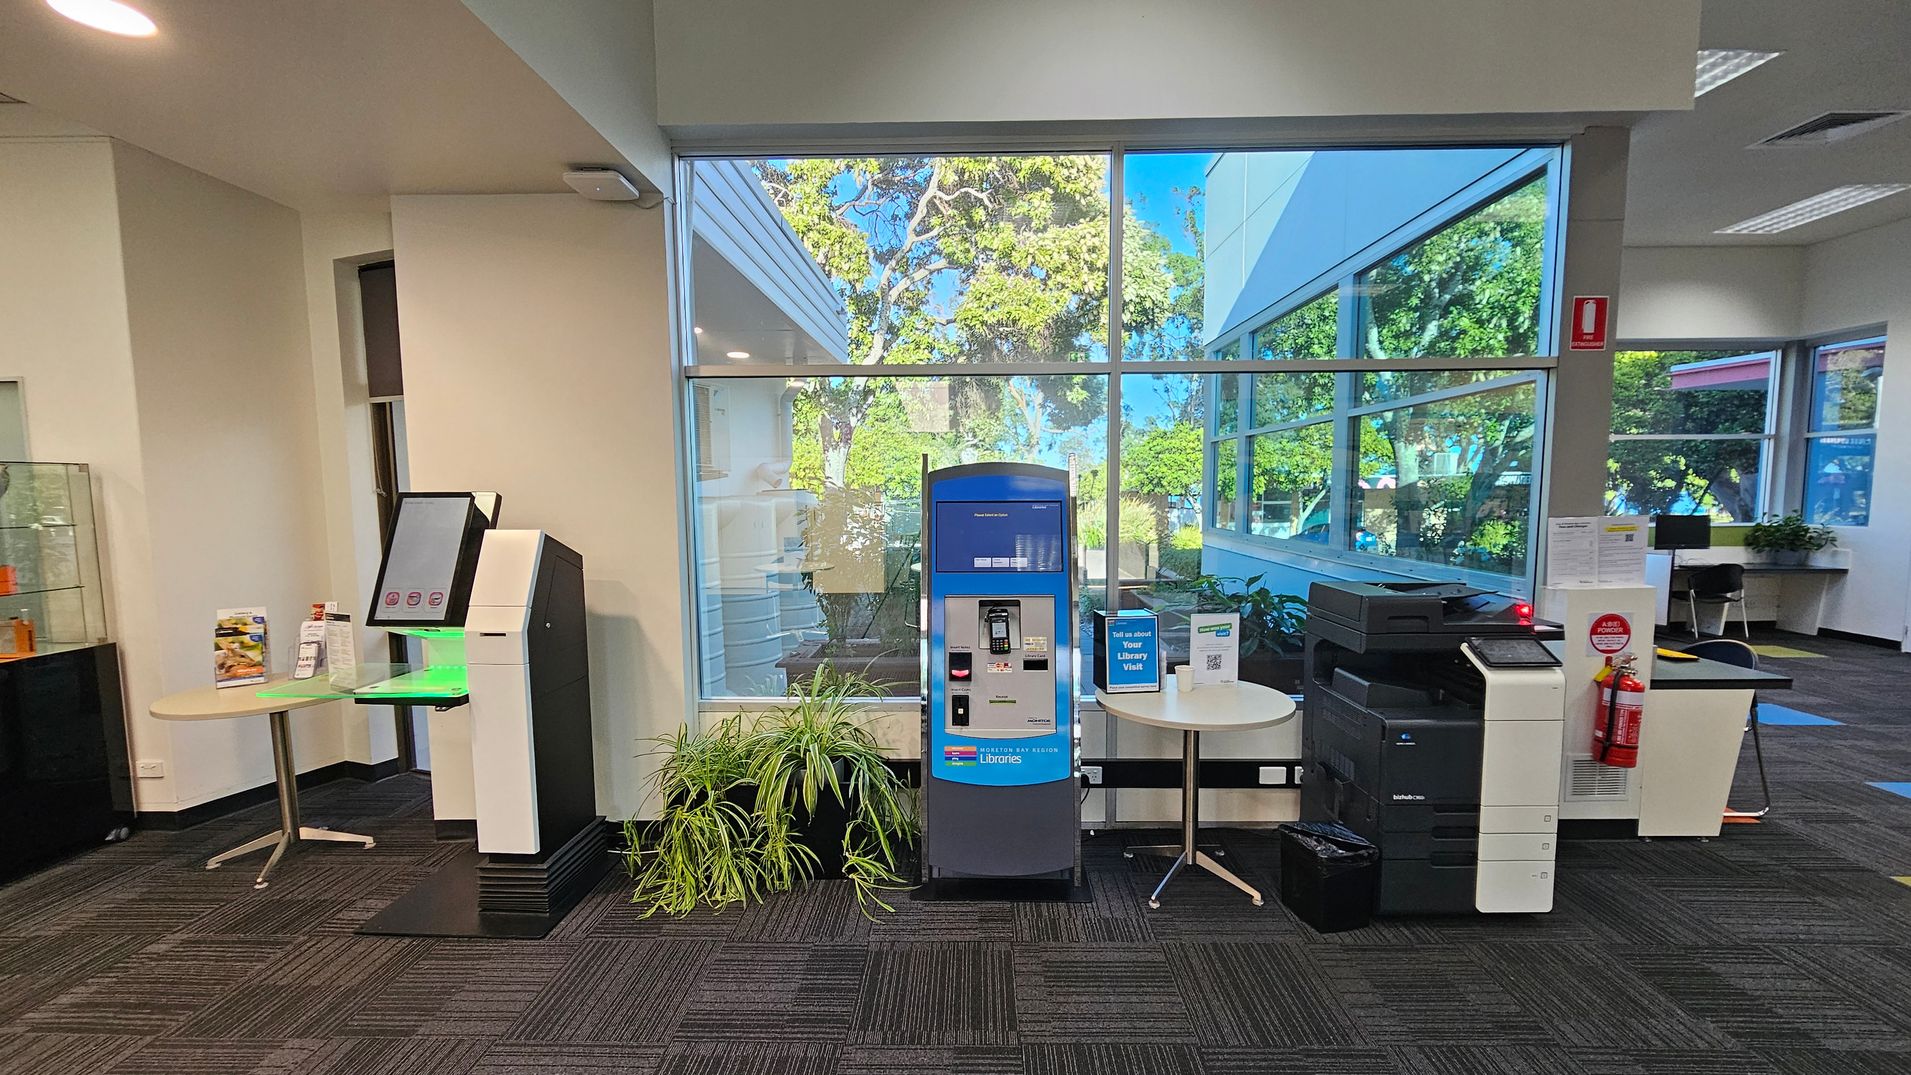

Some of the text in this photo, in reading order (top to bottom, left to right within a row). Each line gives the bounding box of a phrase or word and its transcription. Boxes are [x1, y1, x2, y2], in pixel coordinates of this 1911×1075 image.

[1122, 640, 1142, 649] Your
[1117, 652, 1148, 660] Library
[1123, 663, 1143, 671] Visit
[980, 753, 1022, 764] Libraries
